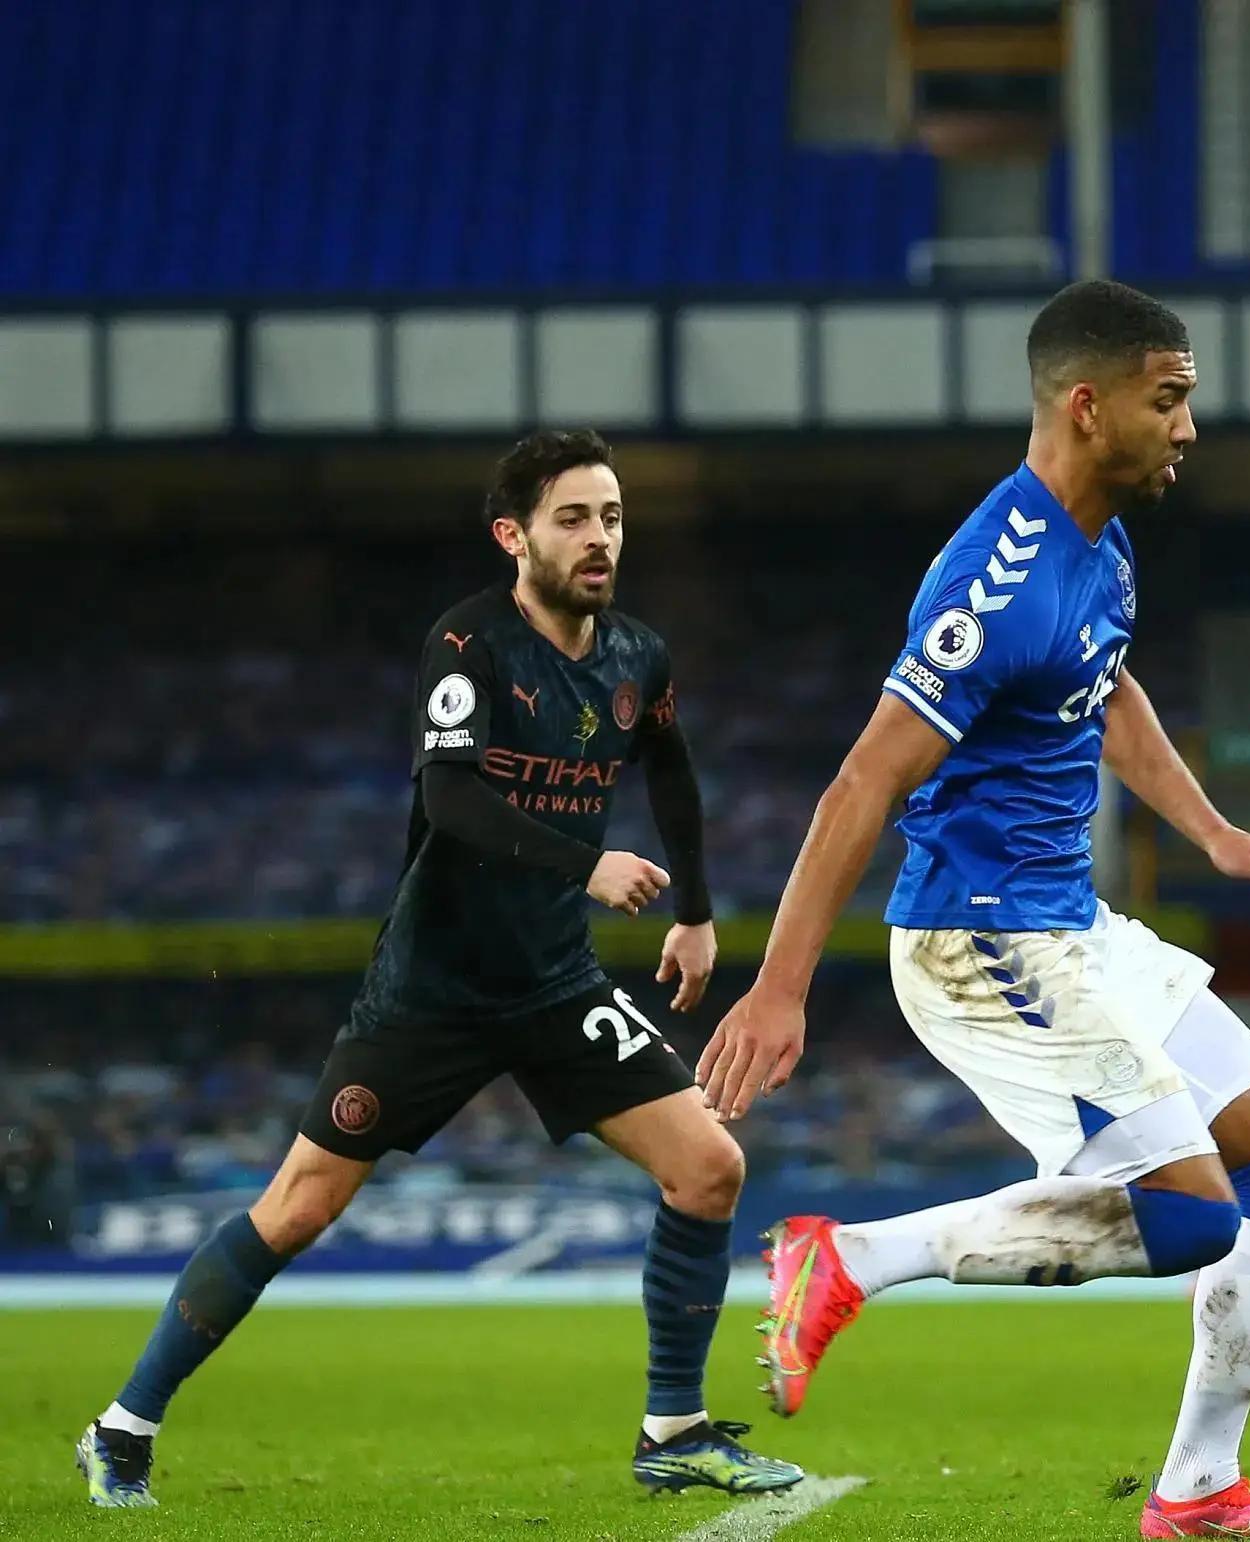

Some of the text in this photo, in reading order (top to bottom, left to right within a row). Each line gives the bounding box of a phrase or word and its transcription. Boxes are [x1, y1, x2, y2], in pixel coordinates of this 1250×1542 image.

[914, 664, 945, 692] room
[440, 729, 469, 740] room
[506, 789, 602, 813] AIRWAYS
